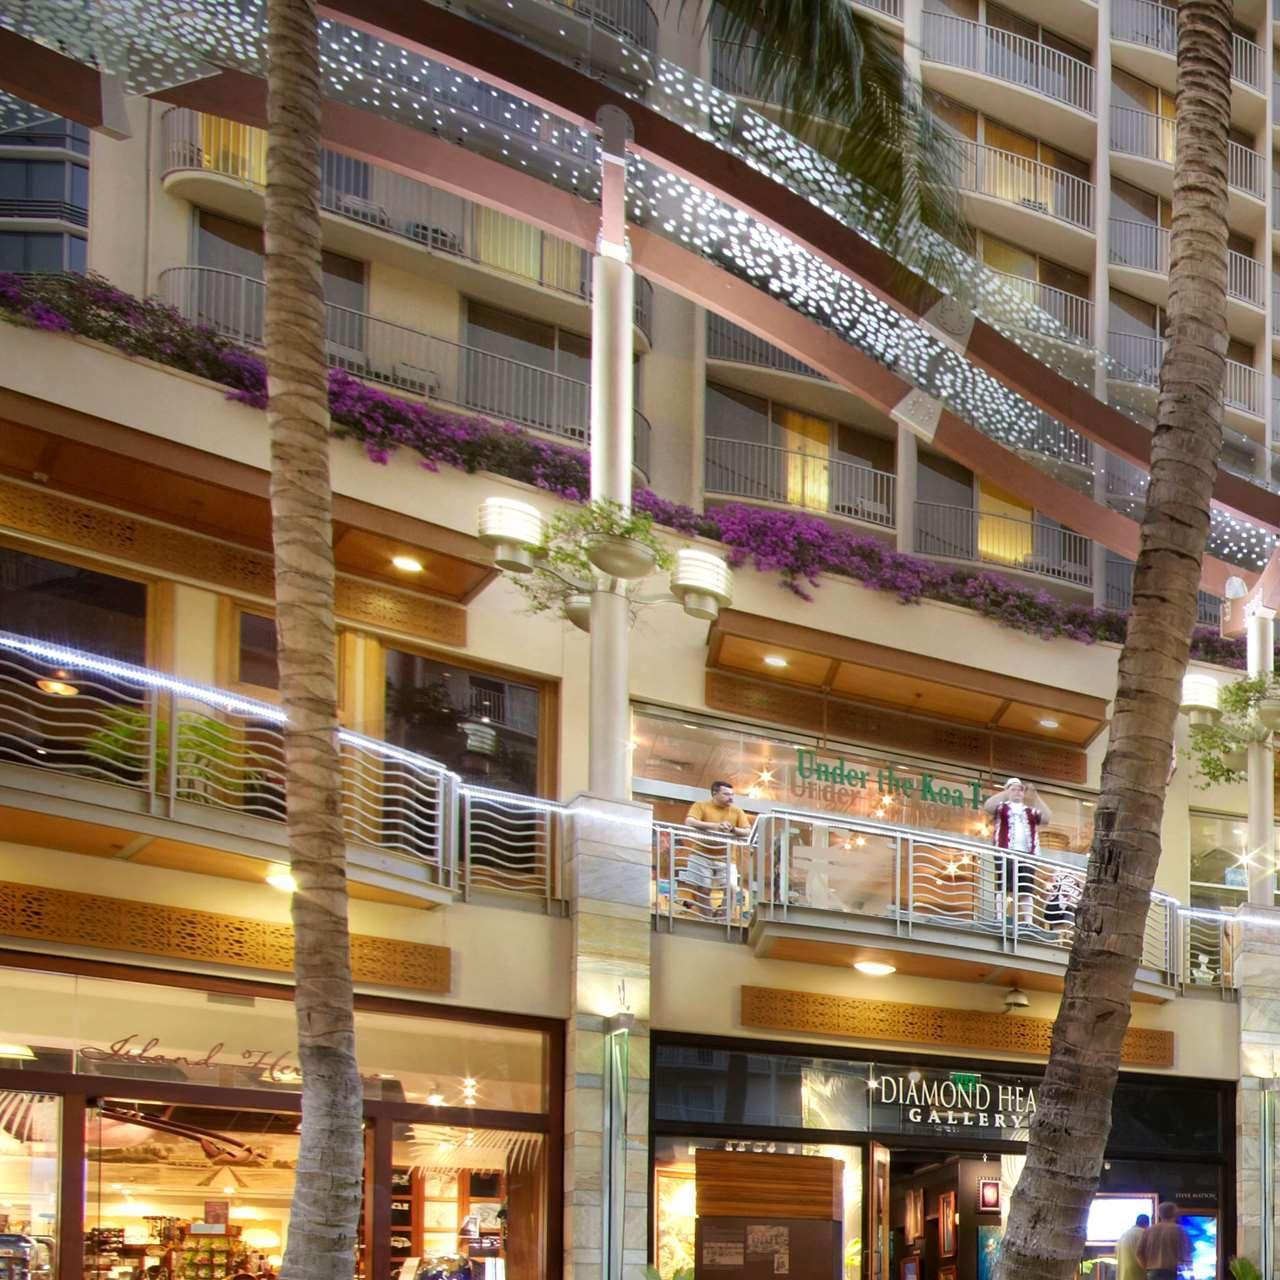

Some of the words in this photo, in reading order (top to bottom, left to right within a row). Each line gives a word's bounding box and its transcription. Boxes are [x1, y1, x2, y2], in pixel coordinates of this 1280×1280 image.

[797, 749, 869, 789] Under
[877, 763, 915, 797] the
[920, 771, 964, 808] Koa
[79, 1034, 224, 1069] Island
[881, 1076, 991, 1110] DIAMOND
[998, 1085, 1038, 1113] HEA
[909, 1108, 1025, 1128] GALLERY
